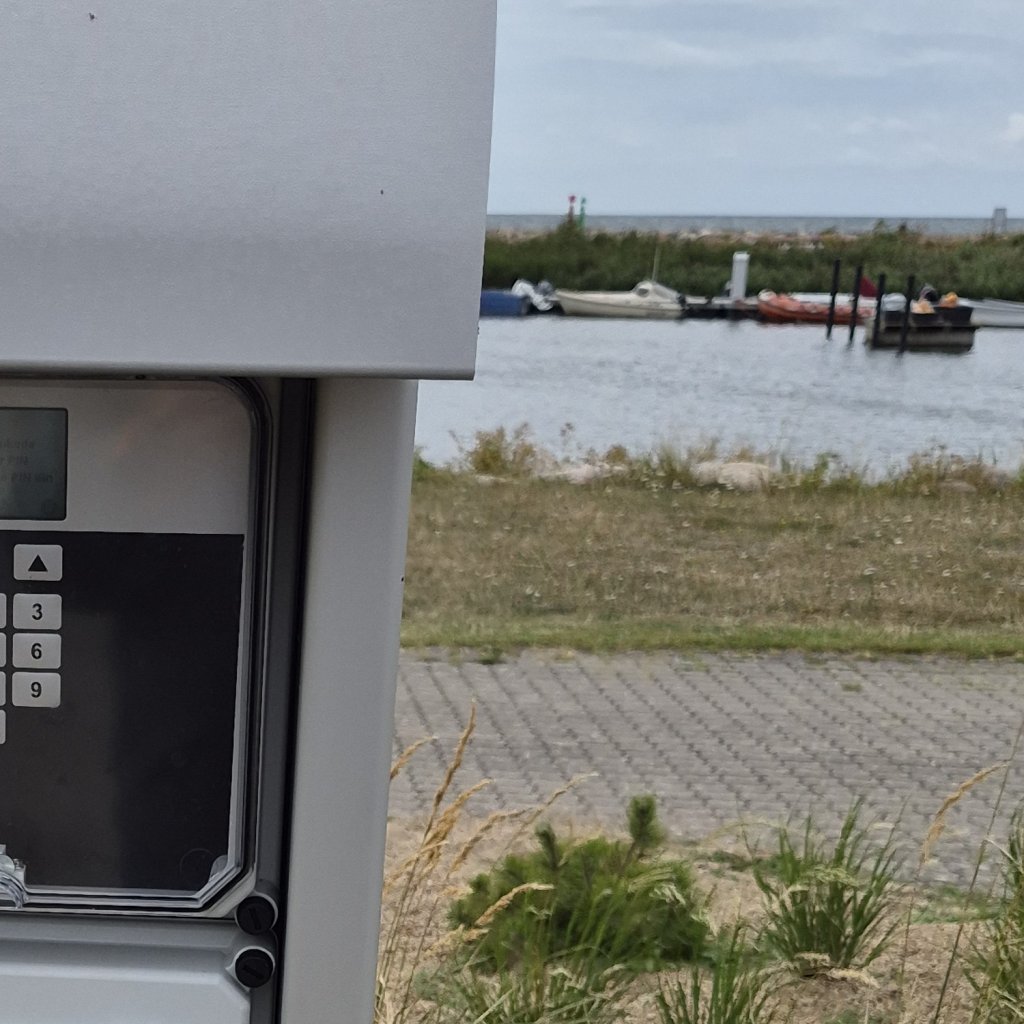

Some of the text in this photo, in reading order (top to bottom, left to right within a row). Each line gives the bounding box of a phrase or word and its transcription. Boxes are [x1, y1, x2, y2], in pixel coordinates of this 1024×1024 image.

[32, 603, 43, 620] 3
[31, 643, 42, 659] 6
[31, 681, 42, 698] 9
